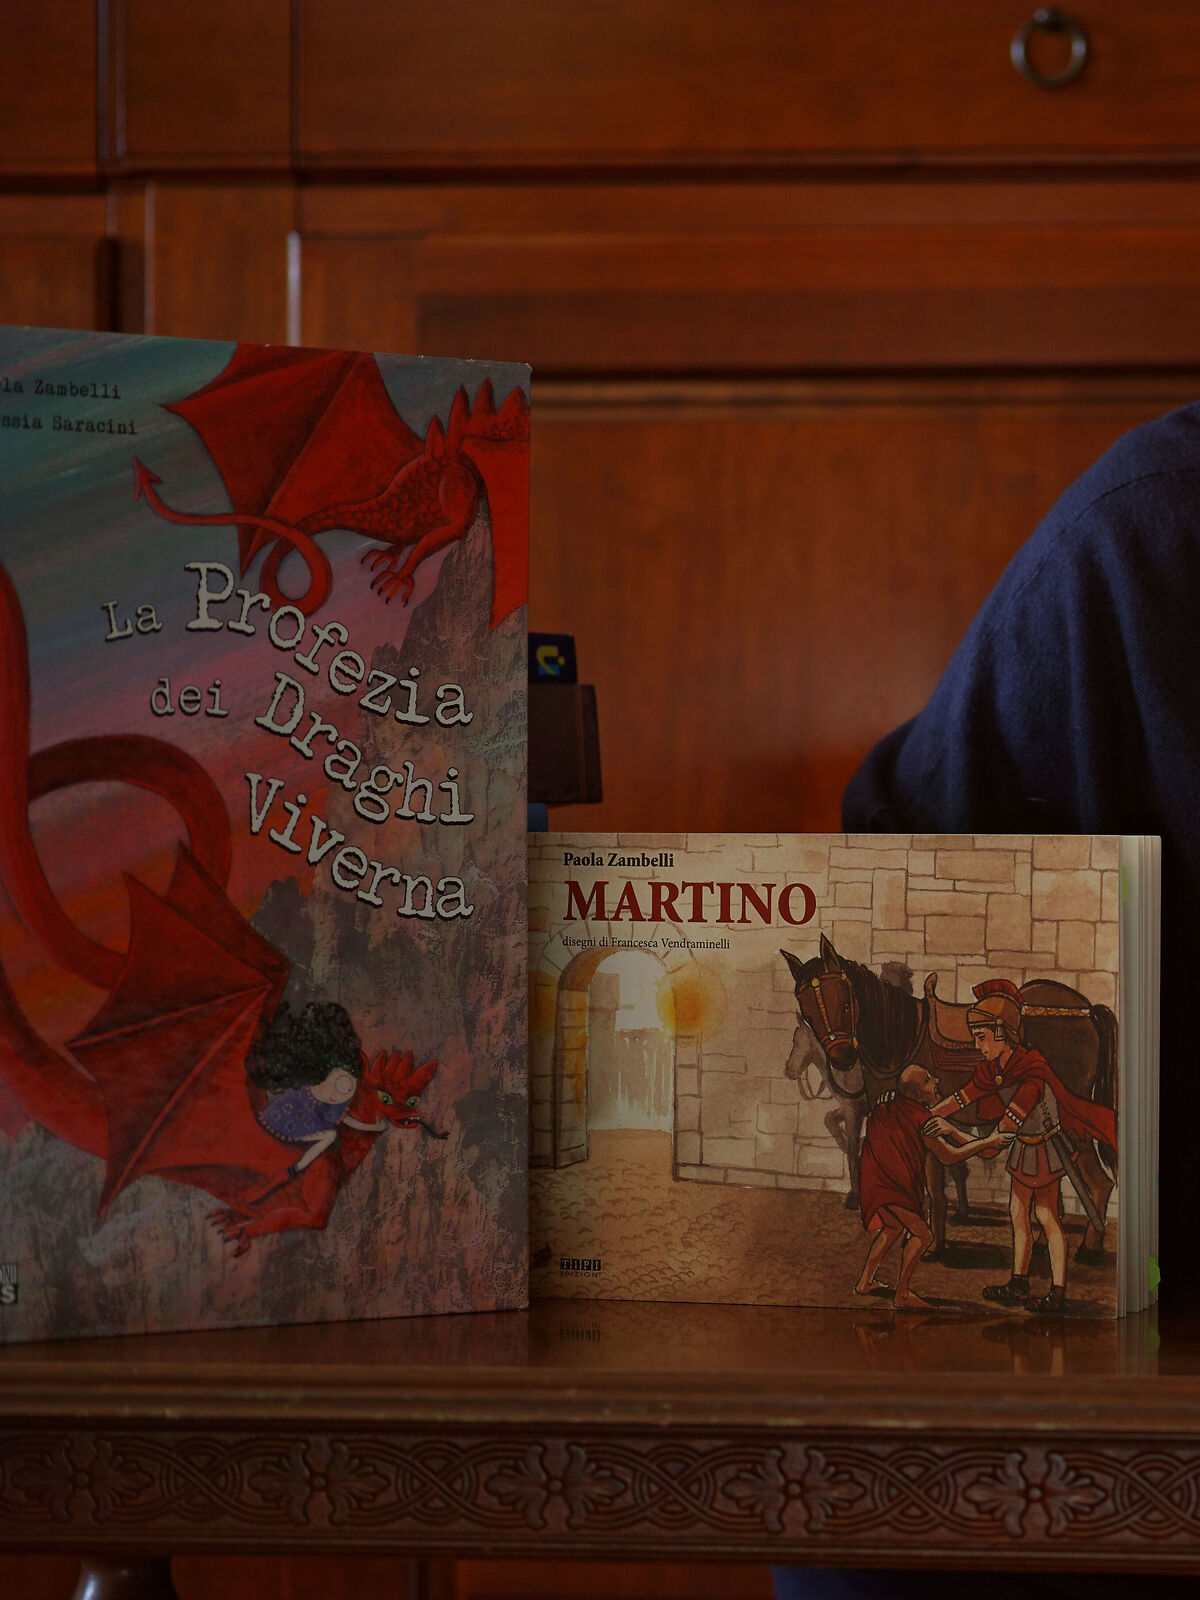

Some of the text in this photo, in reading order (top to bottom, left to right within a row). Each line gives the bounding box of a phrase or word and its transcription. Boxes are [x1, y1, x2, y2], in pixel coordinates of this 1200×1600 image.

[34, 379, 121, 399] Zambelli
[52, 415, 138, 435] Saracini
[102, 561, 474, 727] La Profezia
[150, 671, 475, 824] dei Draghi
[244, 772, 474, 919] Viverna
[563, 852, 675, 867] Paola Zambelli
[563, 879, 817, 926] MARTINO
[562, 936, 730, 949] disegni di Francesca Vendraminelli
[560, 1258, 601, 1271] TIPI
